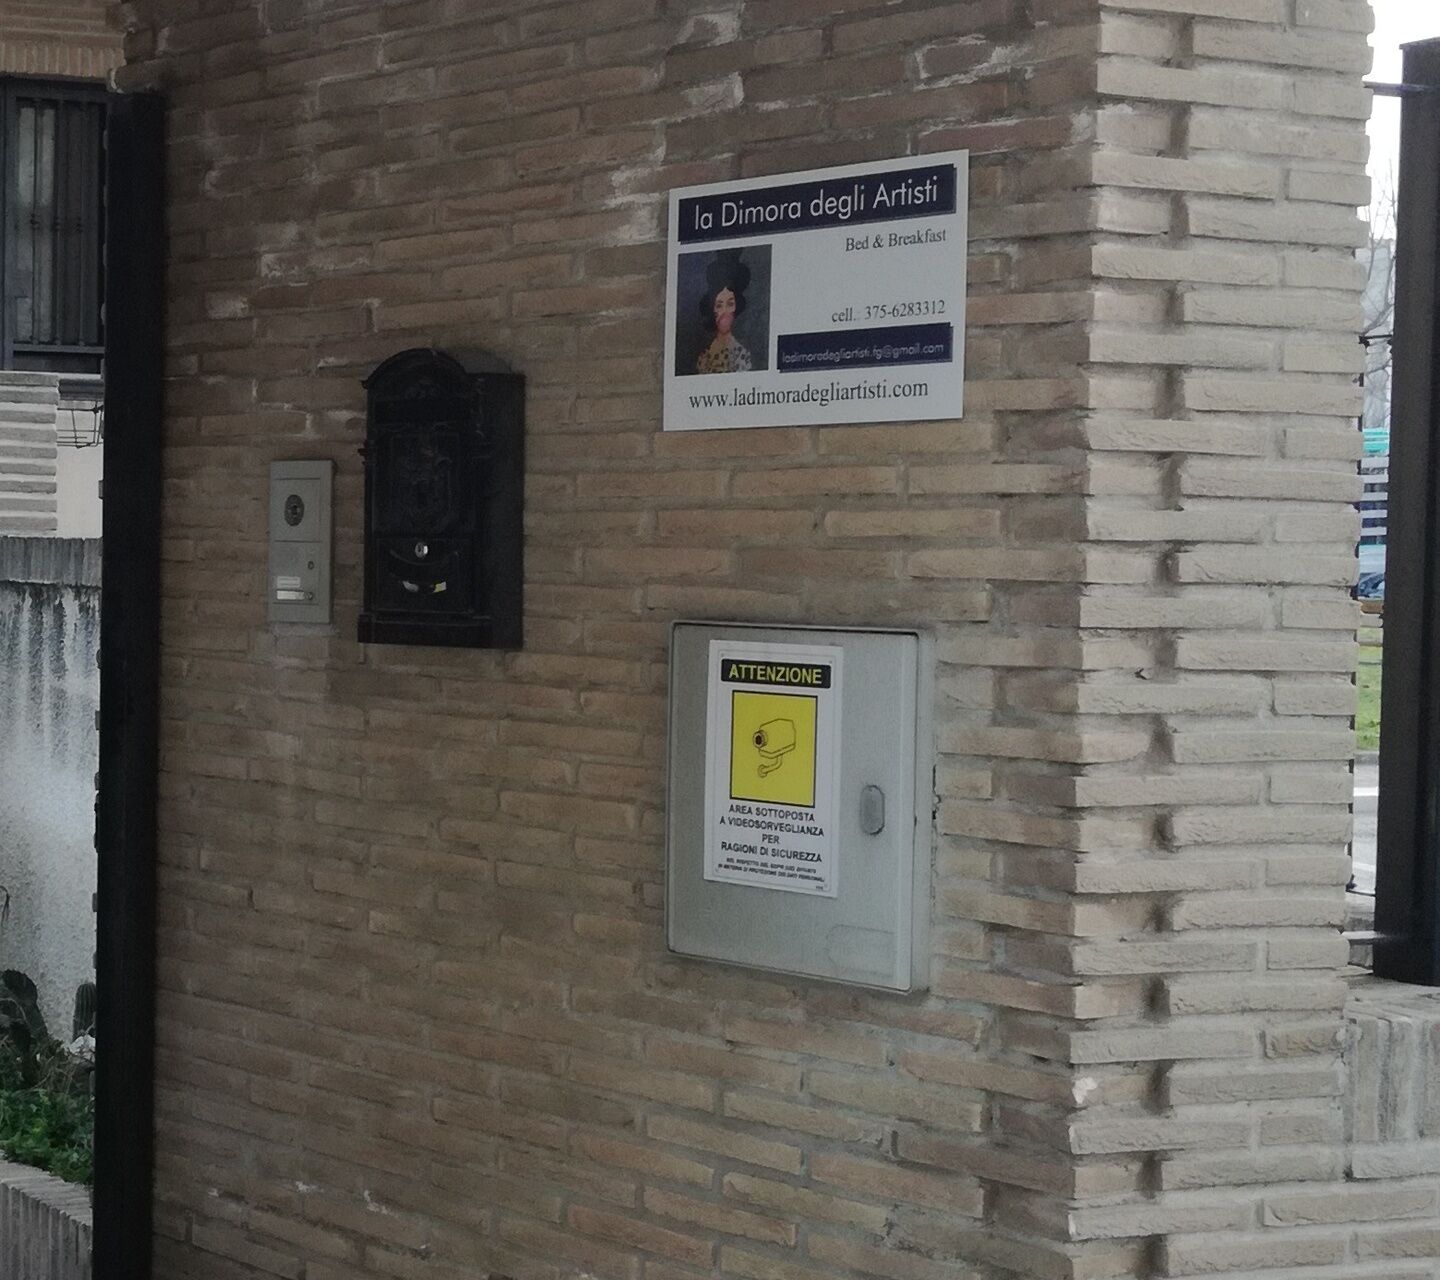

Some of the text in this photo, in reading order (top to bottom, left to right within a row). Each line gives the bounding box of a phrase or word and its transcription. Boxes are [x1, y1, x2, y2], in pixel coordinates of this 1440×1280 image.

[694, 175, 938, 230] la Dimora degli Artisti
[845, 228, 947, 252] Bed & Breakfast
[831, 300, 946, 323] cell. 375-6283312
[689, 380, 929, 408] www.ladimoradegliartisti.com
[728, 663, 822, 684] ATTENZIONE
[728, 804, 815, 821] AREA SOTTOPOSTA
[719, 816, 824, 837] A VIDEOSORVEGLIANZA
[762, 834, 780, 844] PER
[721, 841, 822, 862] RAGIONI DI SICUREZZA
